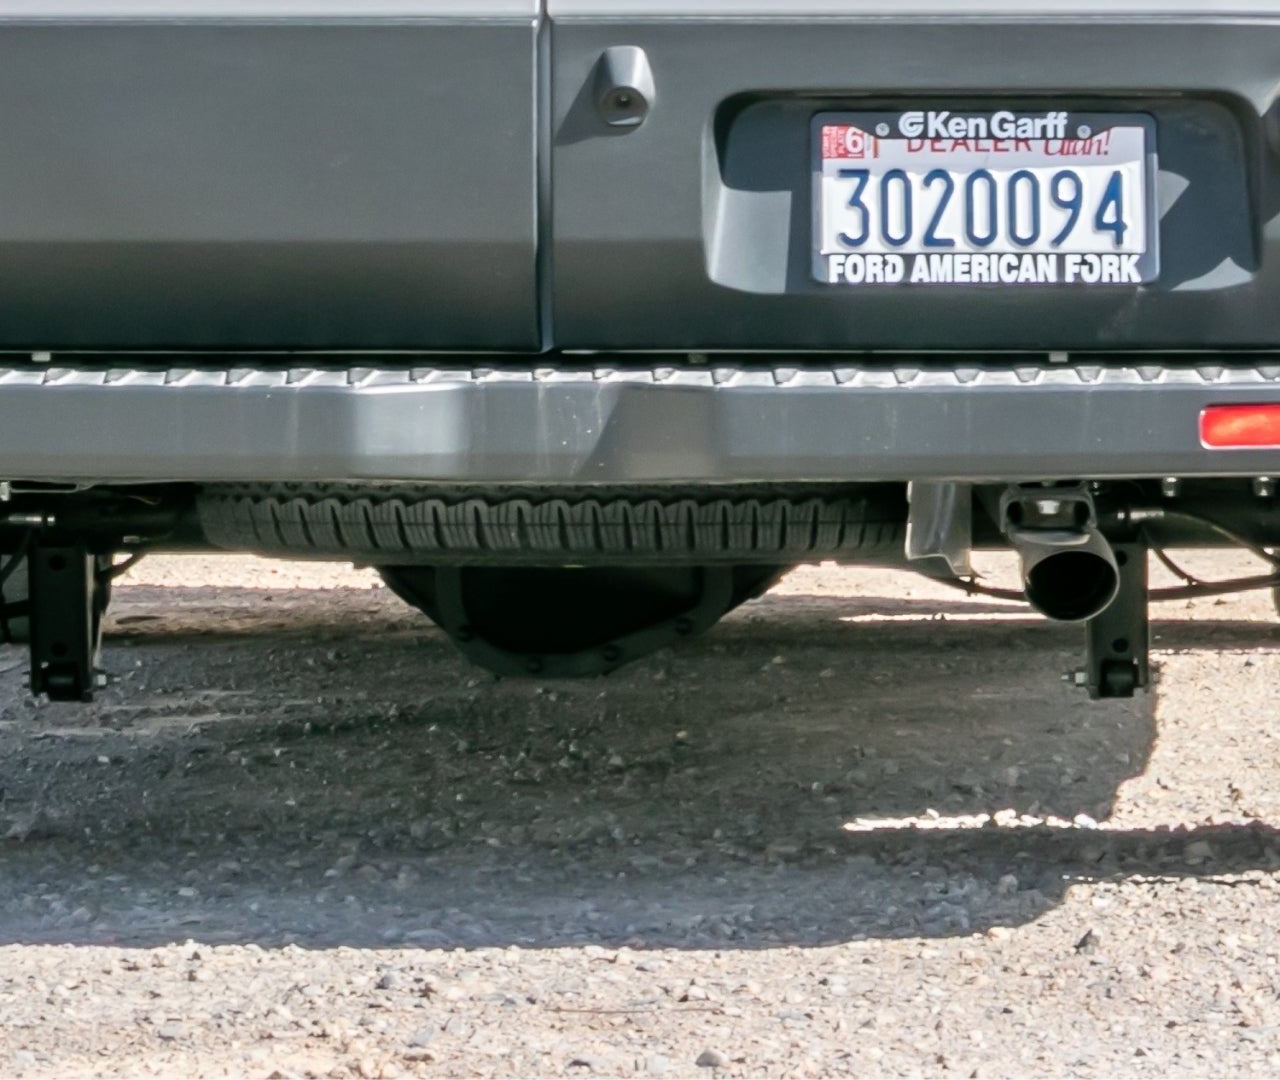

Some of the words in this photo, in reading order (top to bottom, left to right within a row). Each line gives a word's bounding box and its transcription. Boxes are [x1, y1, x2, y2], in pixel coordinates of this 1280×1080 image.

[845, 125, 864, 154] 6
[927, 110, 988, 139] Ken
[990, 110, 1069, 140] Garff
[837, 168, 1128, 248] 3020094
[828, 253, 905, 284] FORD
[910, 253, 1058, 284] AMERICAN
[1065, 253, 1142, 284] FORK
